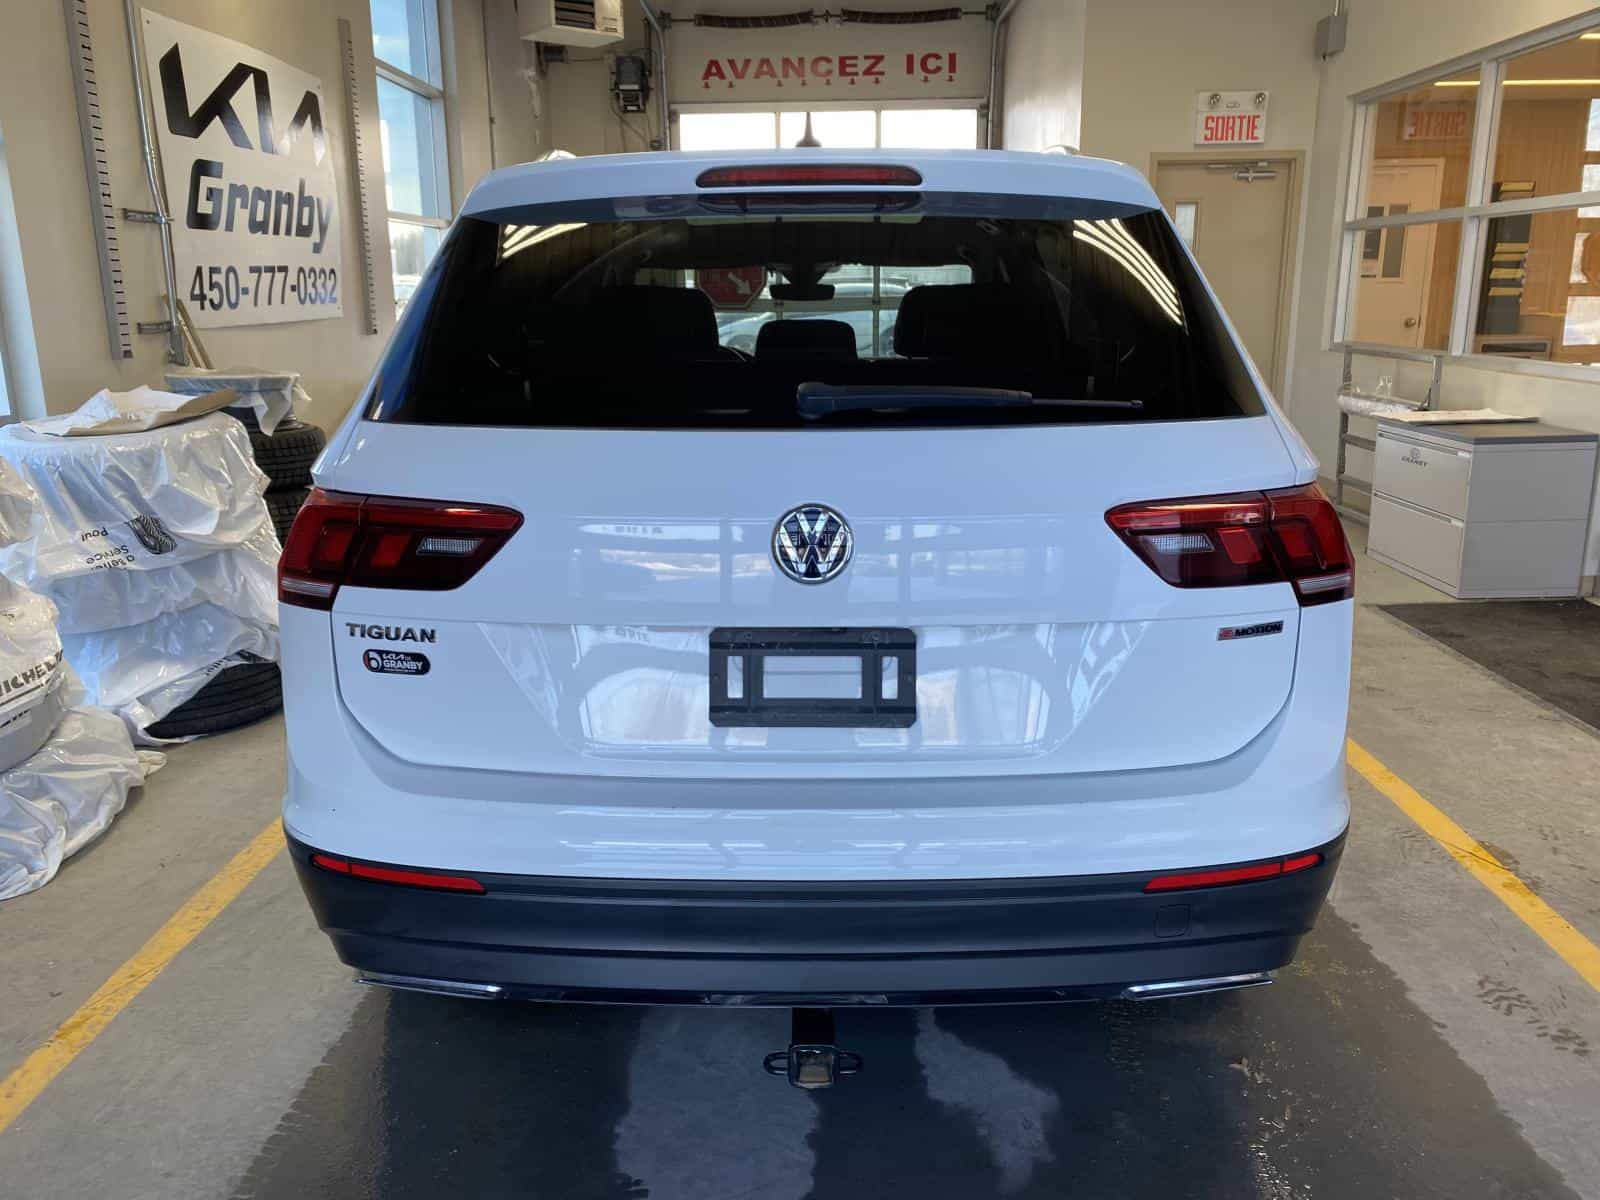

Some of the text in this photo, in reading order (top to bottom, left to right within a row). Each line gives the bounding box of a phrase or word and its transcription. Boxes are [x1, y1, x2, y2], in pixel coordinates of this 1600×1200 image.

[701, 52, 957, 81] AVANCEZ ICI
[158, 41, 328, 167] KIA
[1204, 114, 1261, 141] SORTIE
[186, 158, 334, 254] Granby
[189, 265, 338, 312] 450-777-0332
[345, 621, 437, 643] TIGUAN
[383, 659, 423, 670] GRANBY
